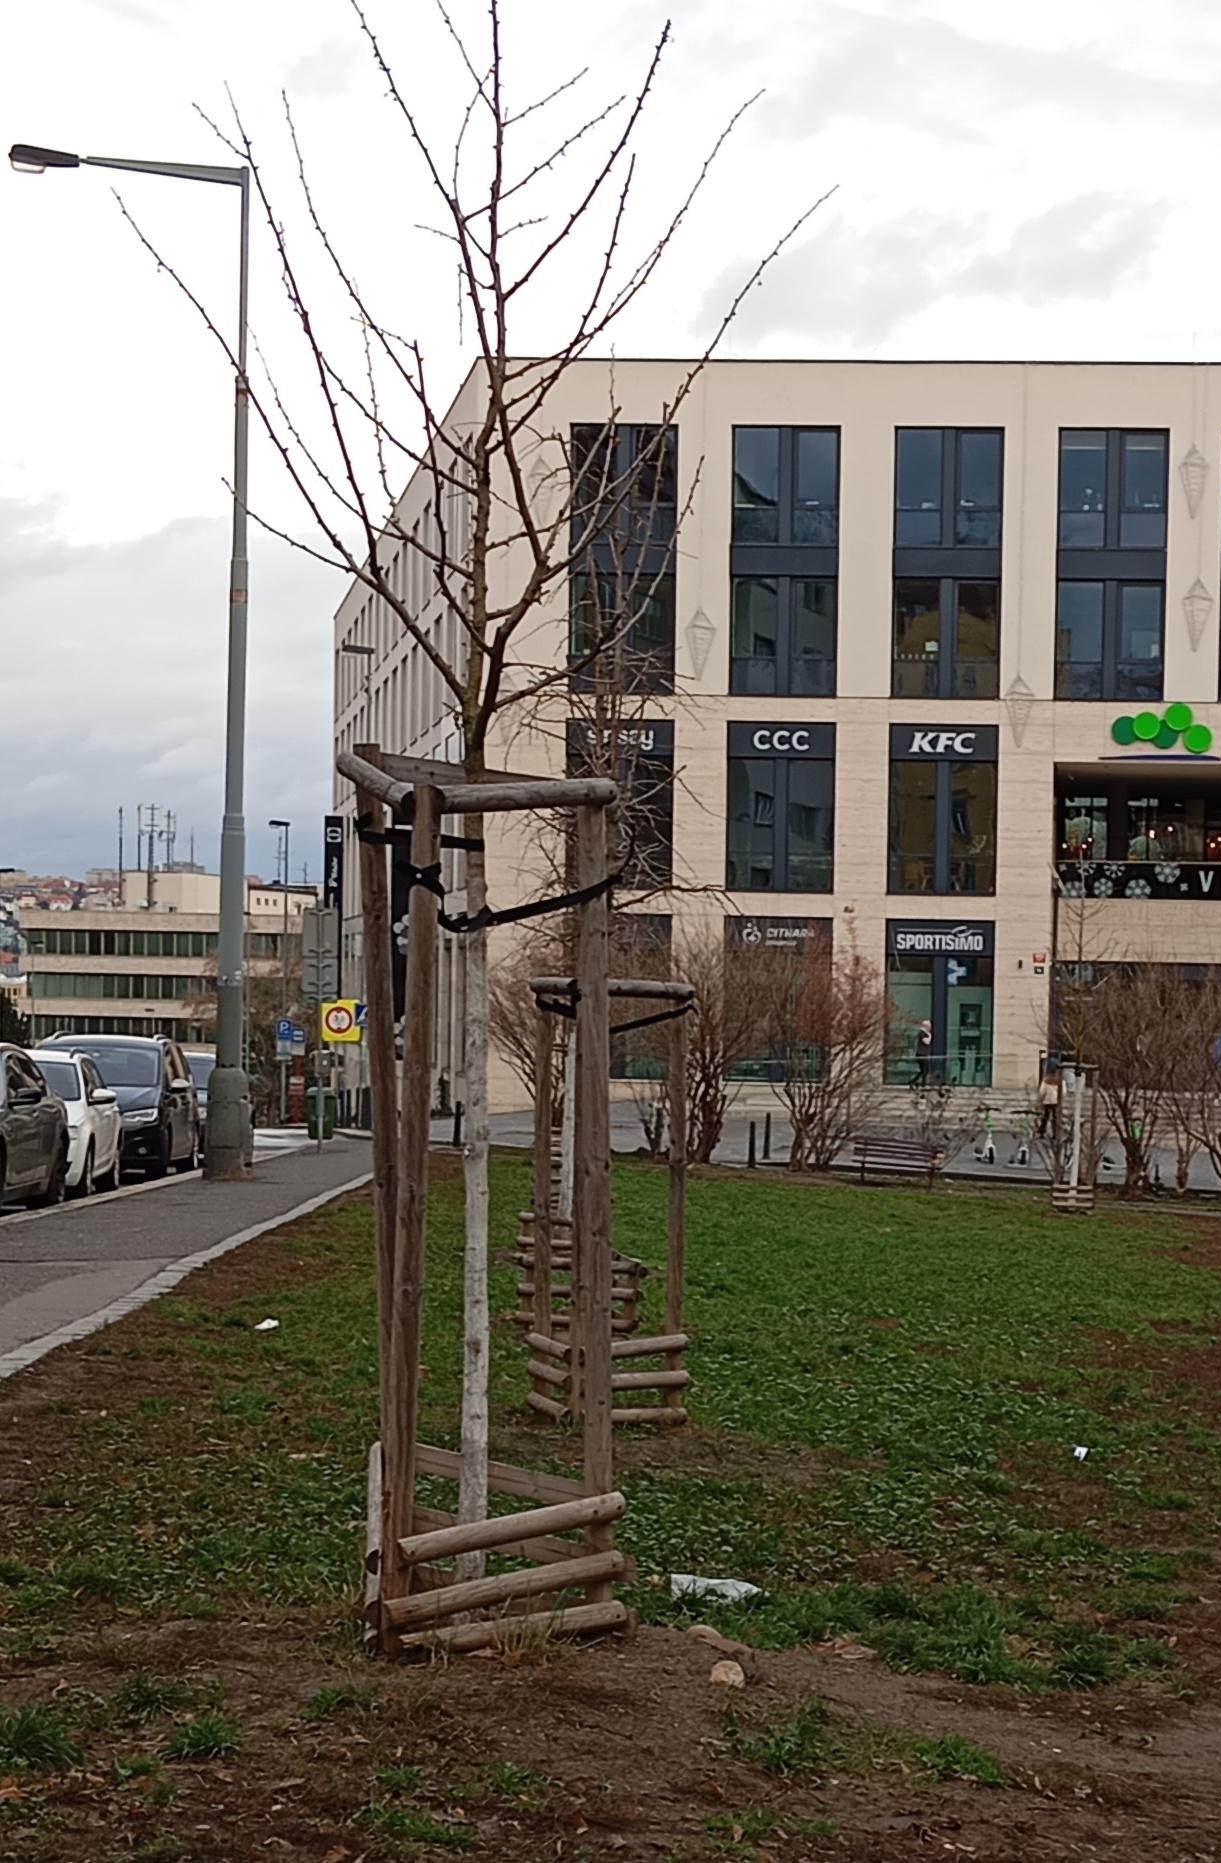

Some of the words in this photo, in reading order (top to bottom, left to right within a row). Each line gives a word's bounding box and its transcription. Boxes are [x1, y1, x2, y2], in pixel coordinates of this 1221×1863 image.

[586, 729, 654, 751] snsay
[753, 729, 810, 751] CCC
[908, 731, 976, 754] KFC
[896, 933, 984, 951] SPORTISIMO
